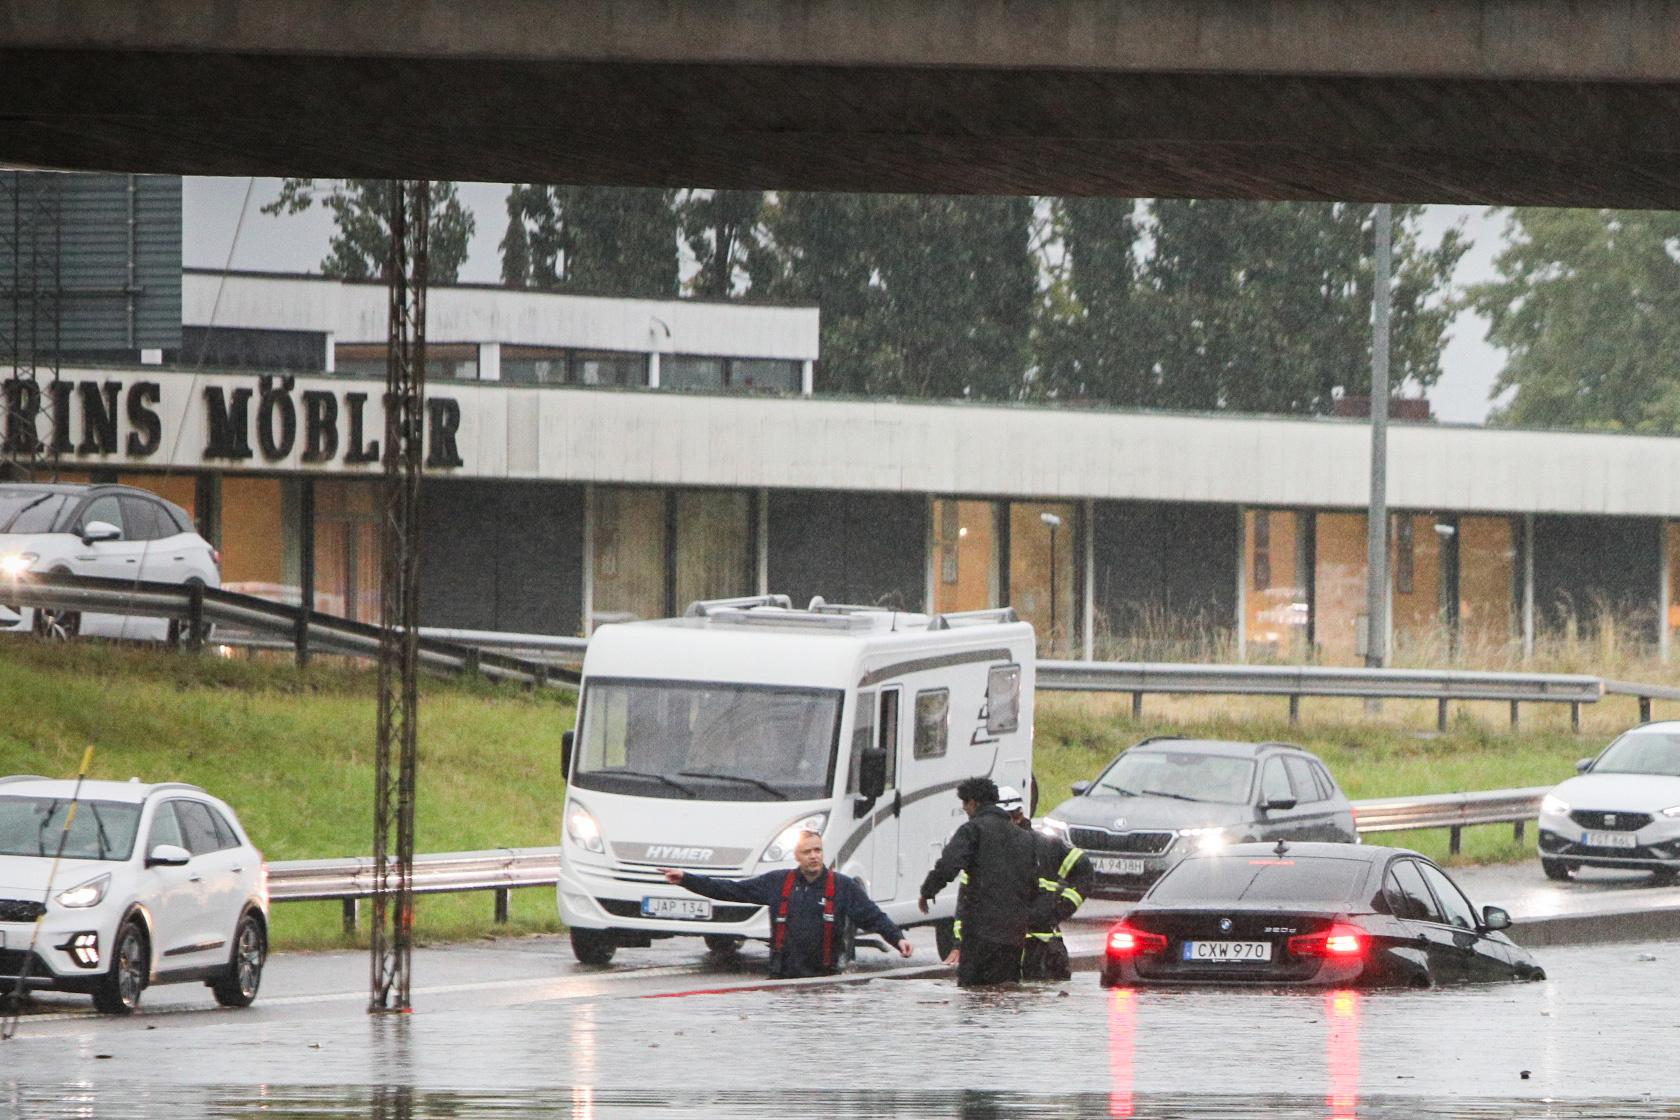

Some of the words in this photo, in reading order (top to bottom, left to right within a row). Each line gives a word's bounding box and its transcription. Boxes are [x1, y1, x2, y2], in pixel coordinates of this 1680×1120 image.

[4, 378, 162, 458] RINS
[645, 845, 714, 860] HYMER
[654, 899, 676, 912] JAP
[683, 901, 704, 913] 134
[1198, 943, 1229, 957] CXW
[1233, 943, 1264, 958] 970
